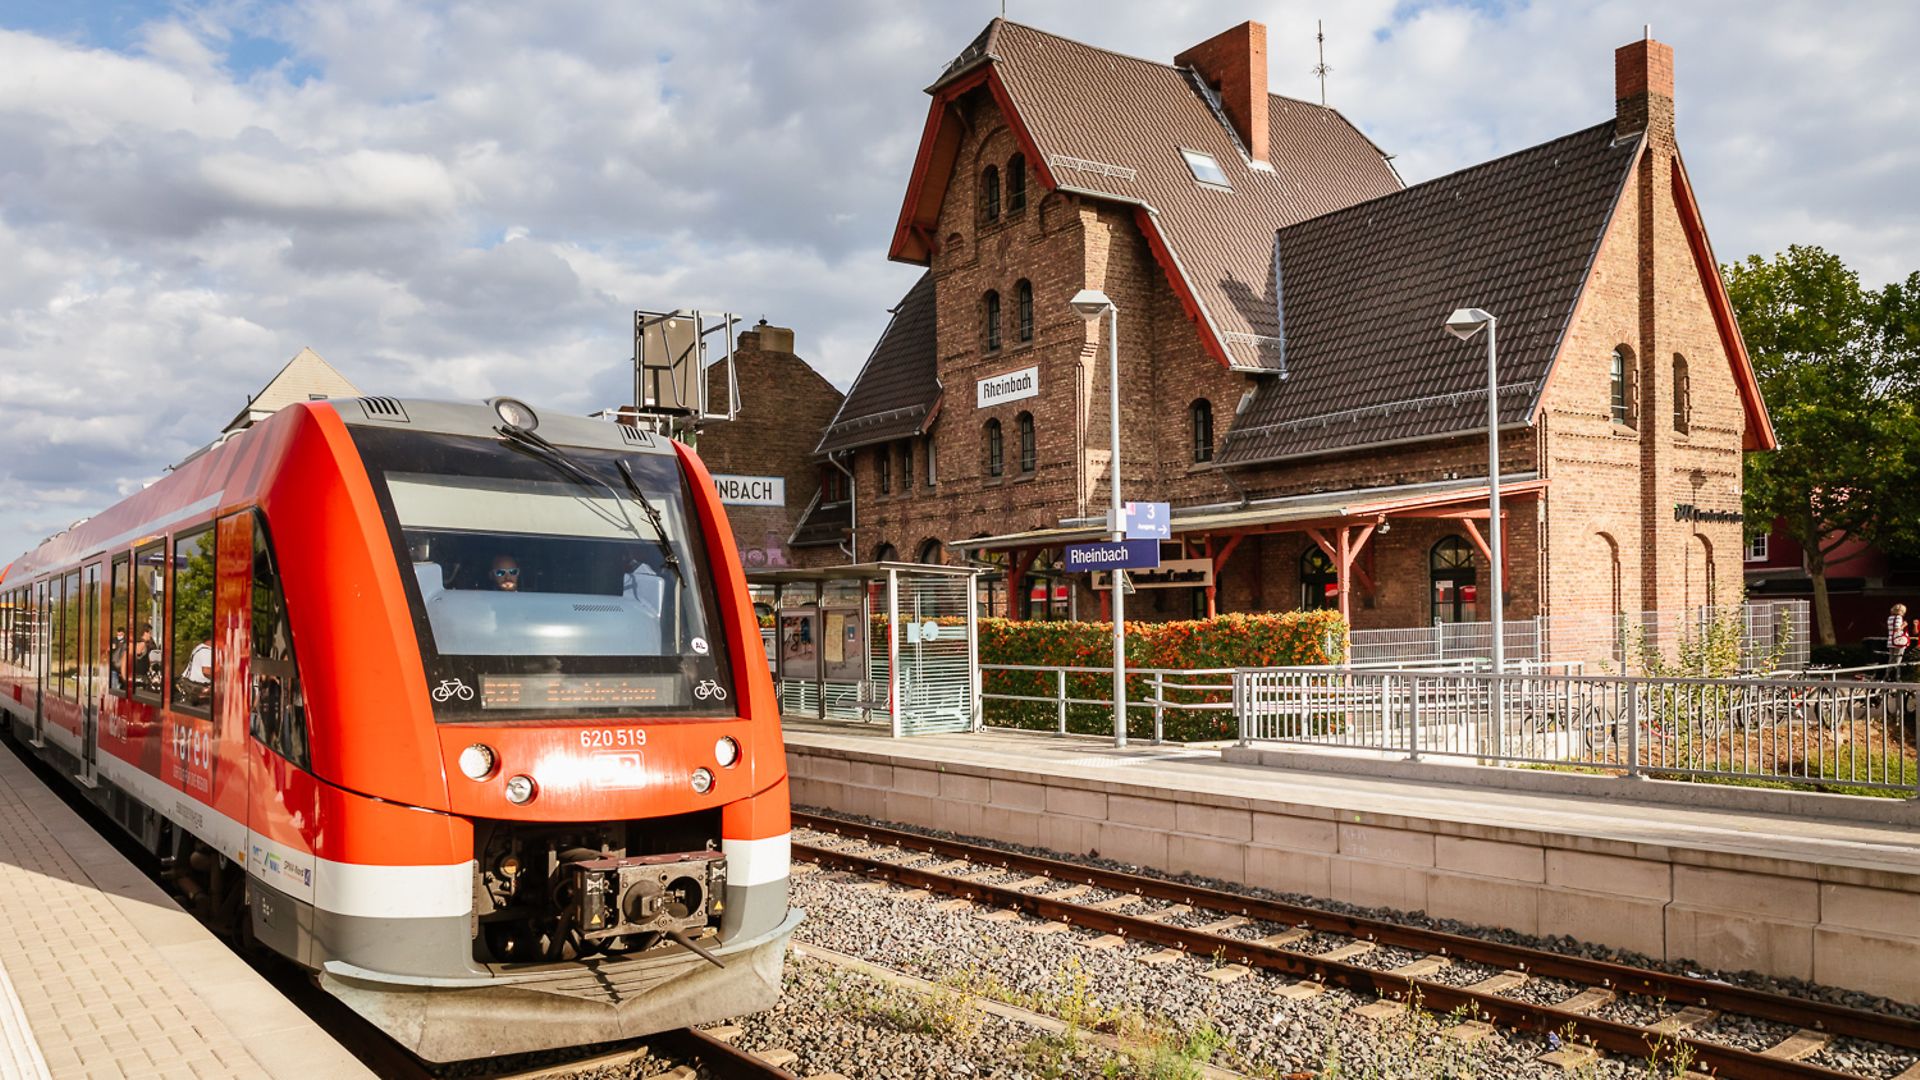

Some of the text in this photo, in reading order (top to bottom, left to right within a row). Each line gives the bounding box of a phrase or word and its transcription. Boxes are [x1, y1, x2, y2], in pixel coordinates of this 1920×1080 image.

[983, 373, 1032, 399] Rheinbach
[1147, 504, 1156, 519] 3
[1071, 546, 1129, 564] Rheinbach
[580, 729, 646, 747] 620 519
